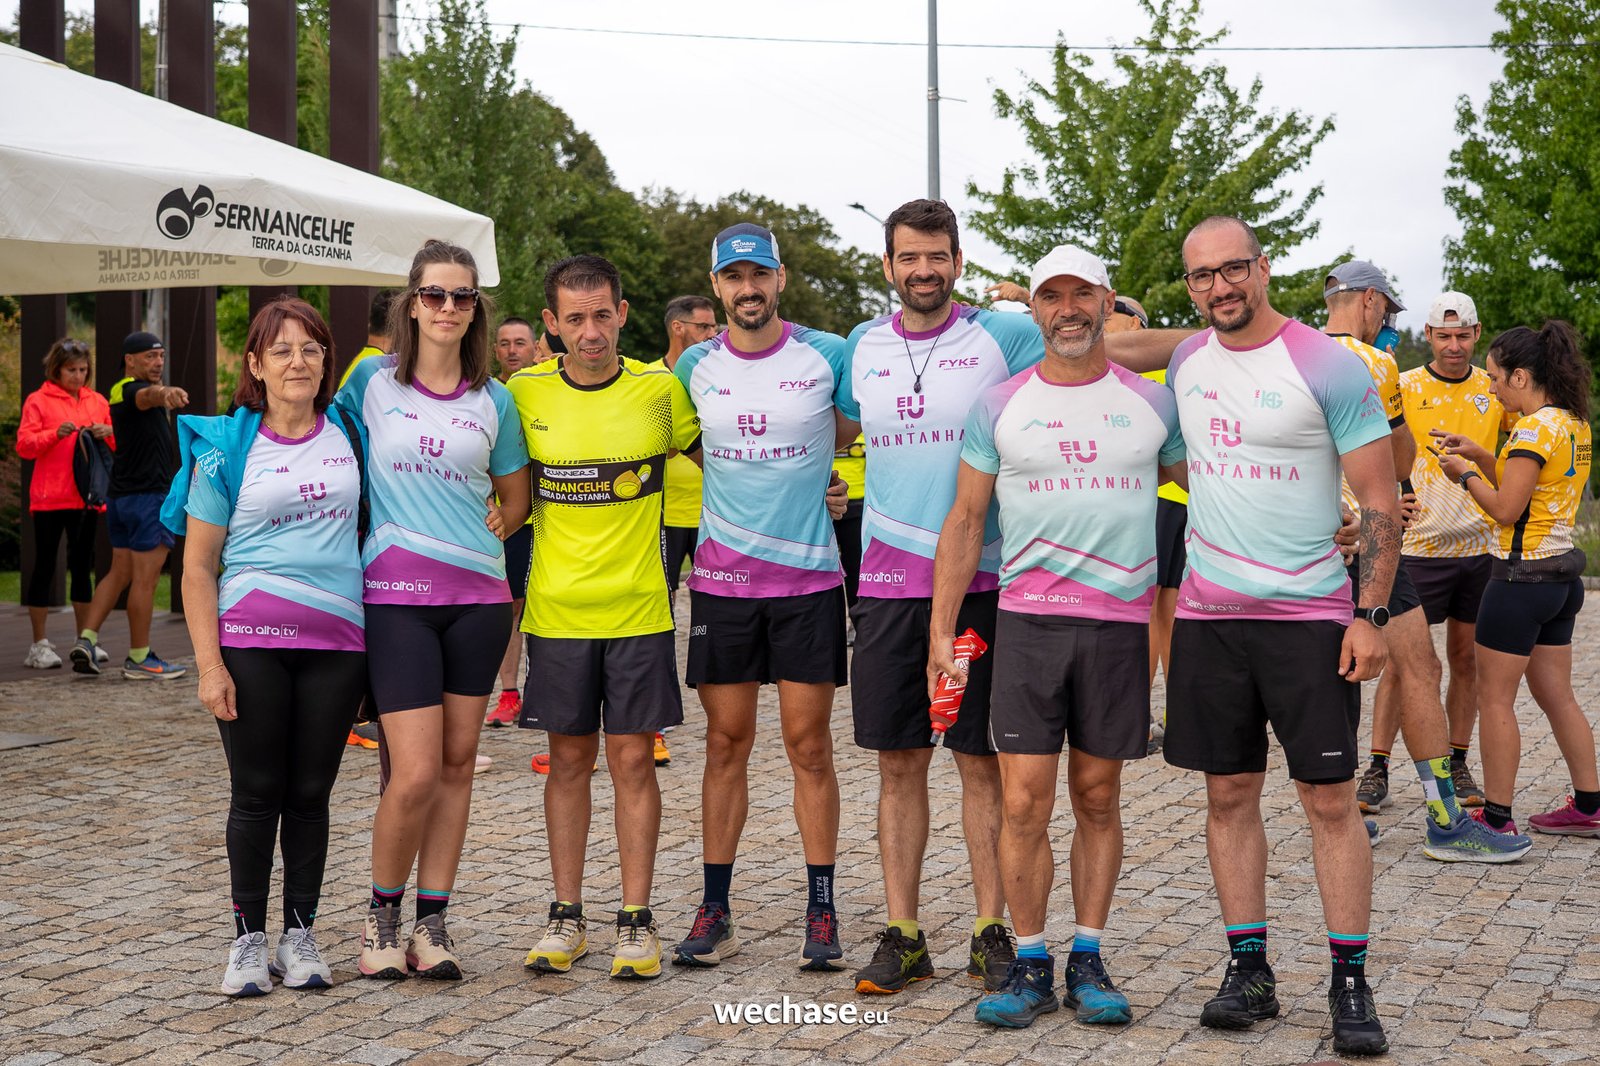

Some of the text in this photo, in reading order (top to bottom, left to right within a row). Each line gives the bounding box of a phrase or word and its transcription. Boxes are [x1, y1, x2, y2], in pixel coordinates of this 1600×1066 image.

[214, 202, 355, 246] SERNANCELHE
[252, 236, 352, 261] TERRA DA CASTANHA
[939, 357, 979, 368] FYKE
[779, 379, 818, 389] FYKE
[546, 469, 596, 477] RUNNERS
[539, 477, 611, 493] SERNANCELHE
[1028, 476, 1142, 493] MONTANHA
[555, 492, 567, 500] DA
[567, 492, 611, 501] CASTANHA
[712, 571, 733, 582] alta
[873, 571, 892, 582] alta
[366, 578, 389, 590] beira
[391, 581, 415, 591] alta
[1023, 591, 1046, 602] beira
[1047, 593, 1068, 603] alta
[1203, 603, 1227, 612] alta
[224, 622, 253, 635] beira
[255, 625, 280, 636] alta
